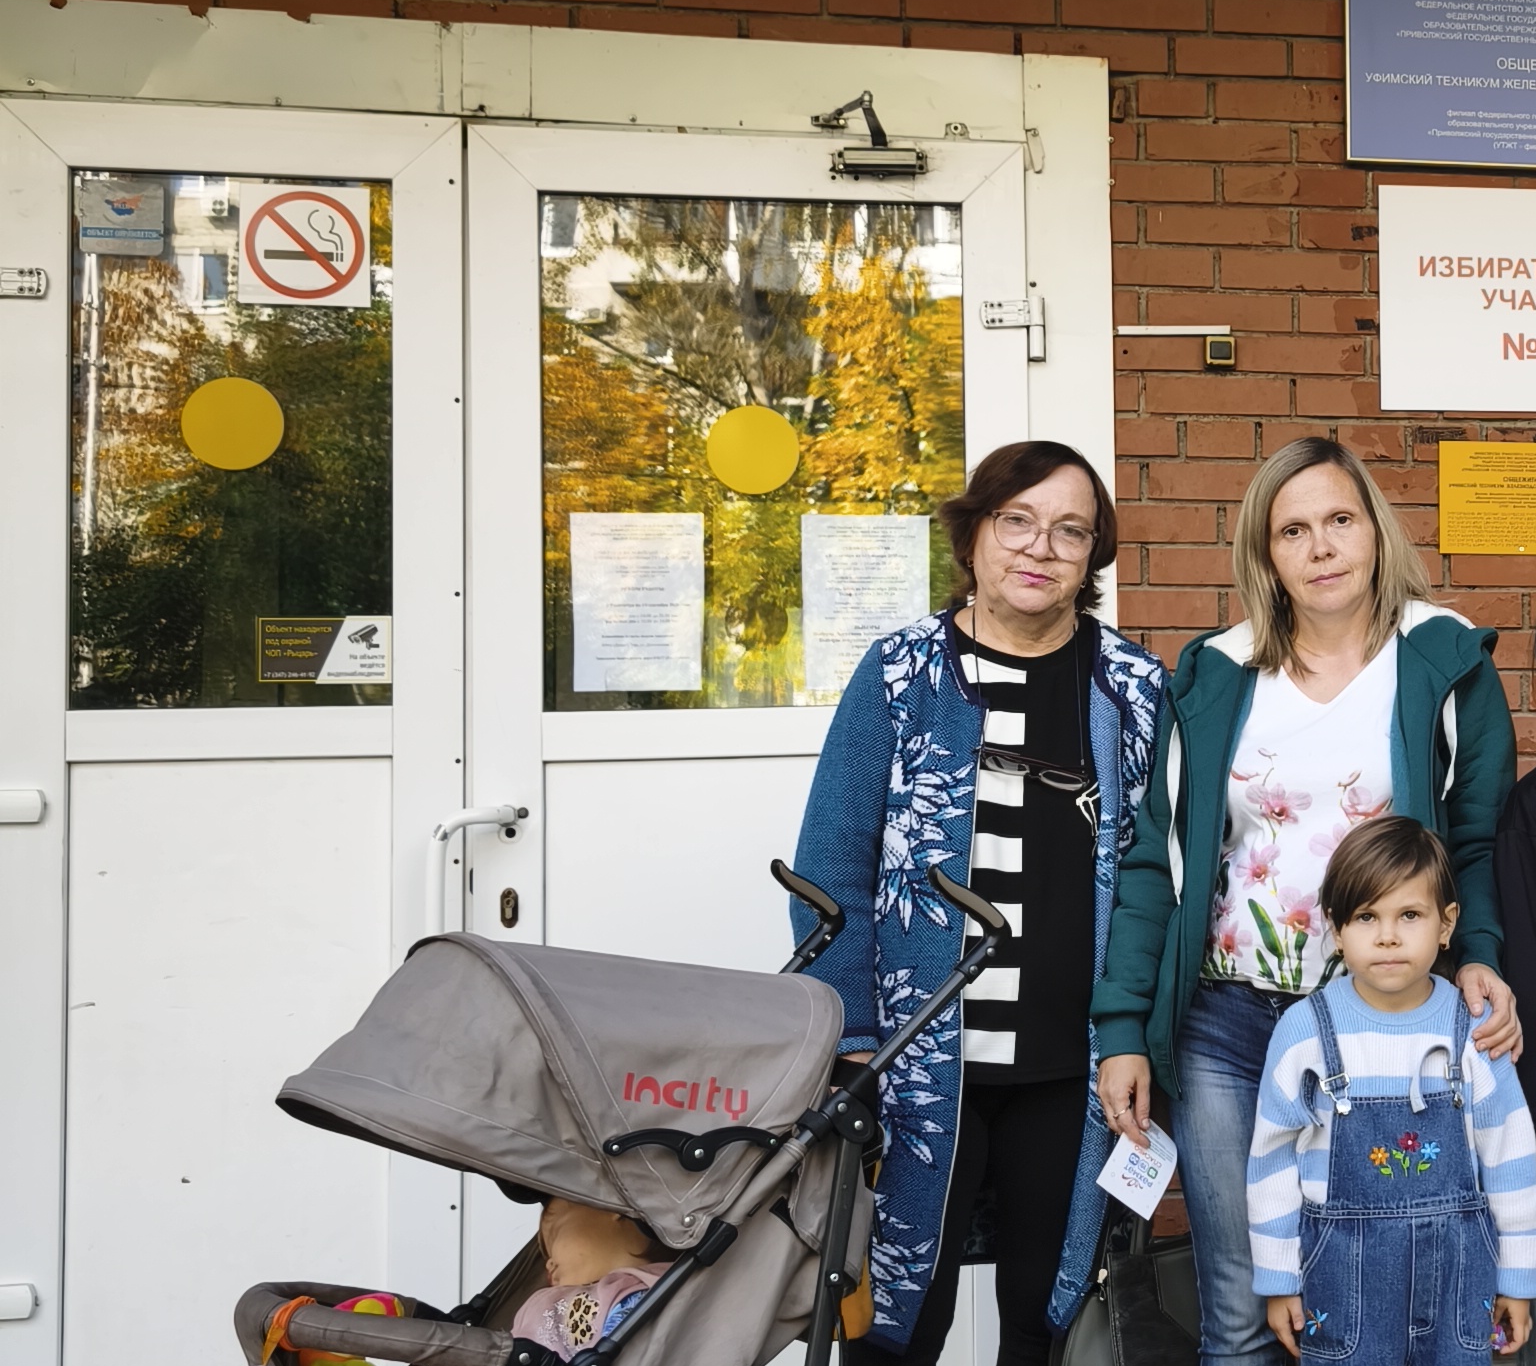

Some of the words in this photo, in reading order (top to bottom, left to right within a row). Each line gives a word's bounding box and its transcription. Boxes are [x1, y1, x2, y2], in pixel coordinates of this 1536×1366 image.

[1415, 0, 1475, 11] ФЕДЕРАЛЬНОЕ
[1476, 3, 1524, 13] АГЕНТСТВО
[1446, 12, 1505, 23] ФЕДЕРАЛЬНОЕ
[1423, 21, 1504, 33] ОБРАЗОВАТЕЛЬНОЕ
[1365, 72, 1433, 85] УФИМСКИЙ
[1435, 75, 1500, 89] ТЕХНИКУМ
